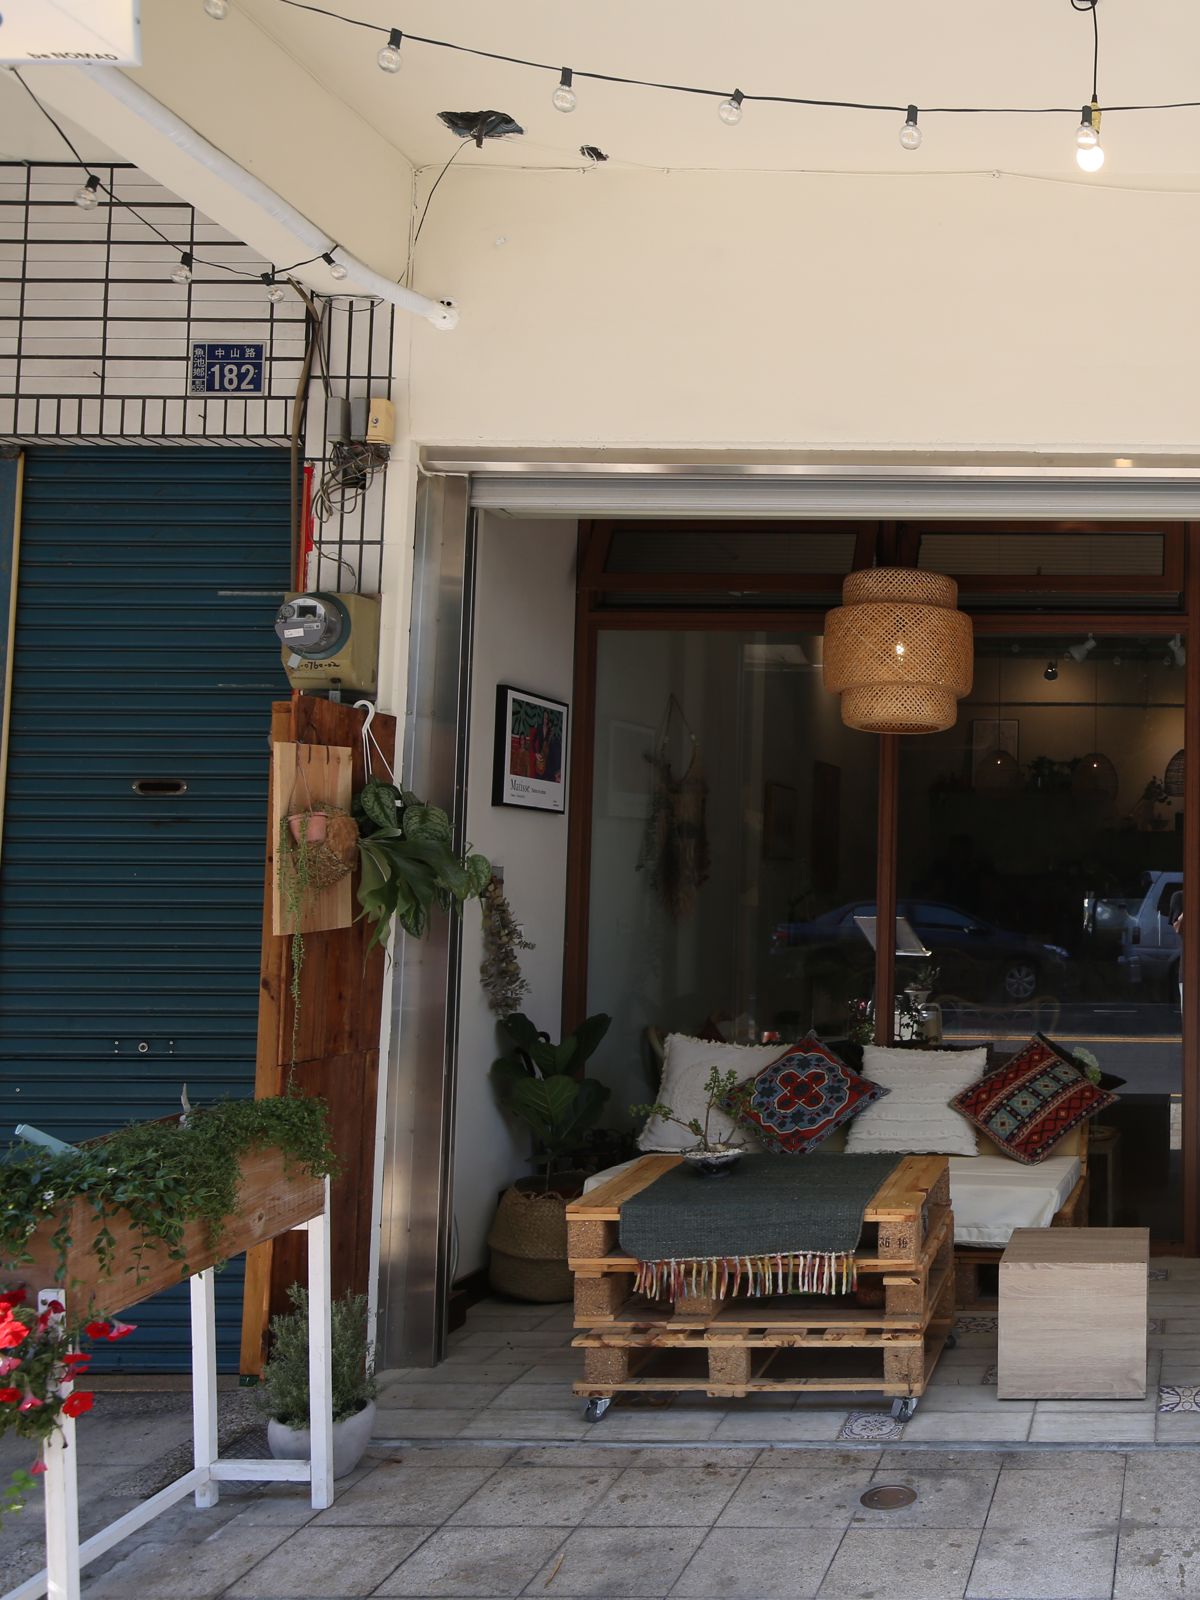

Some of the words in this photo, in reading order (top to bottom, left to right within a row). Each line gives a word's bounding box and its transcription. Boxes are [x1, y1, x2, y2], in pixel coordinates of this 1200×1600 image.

[51, 52, 118, 60] NOMAD
[215, 347, 256, 358] 中山路
[193, 348, 205, 377] 魚池鄉
[210, 364, 255, 390] 182
